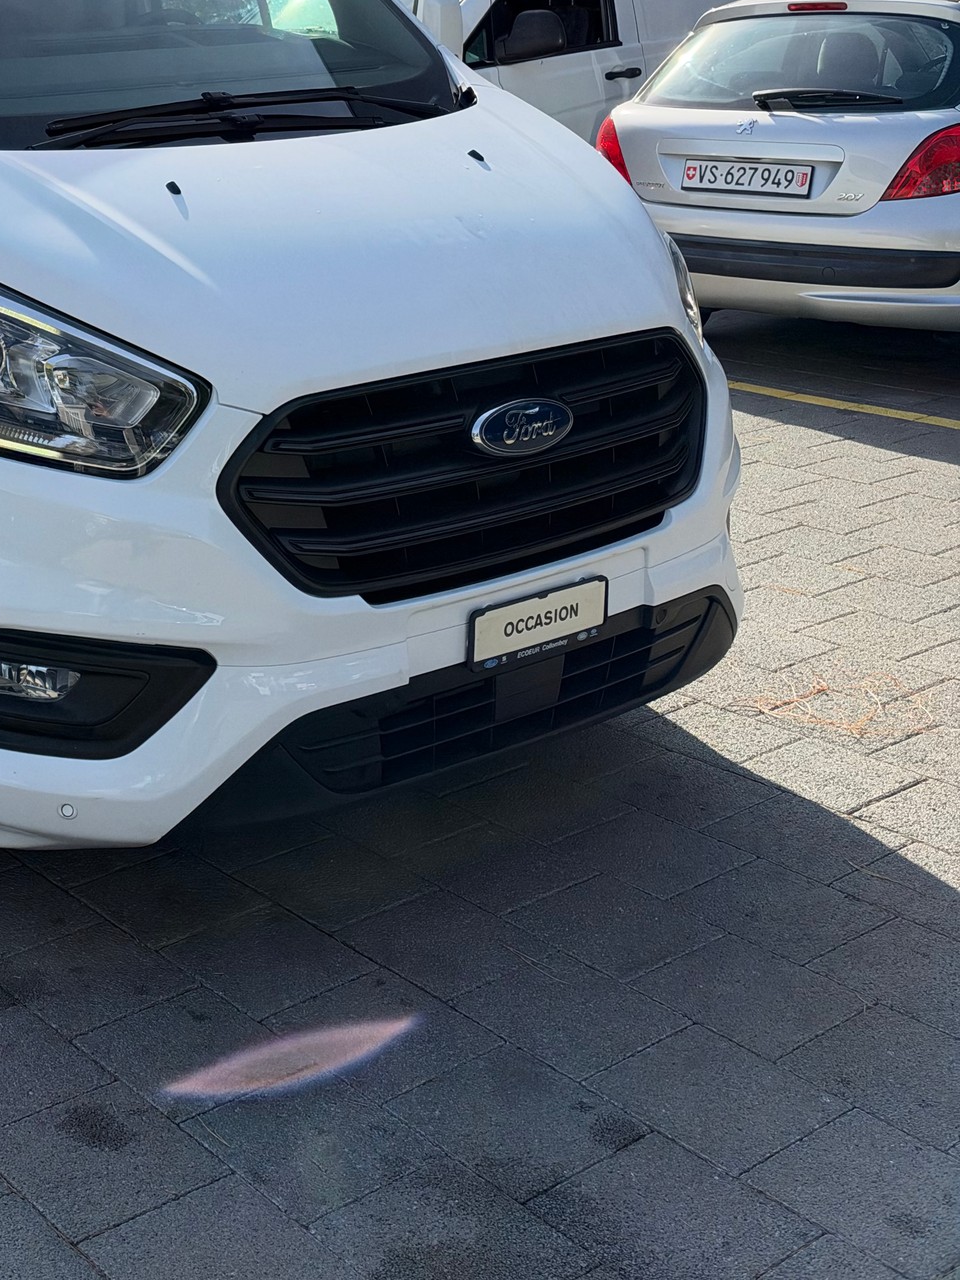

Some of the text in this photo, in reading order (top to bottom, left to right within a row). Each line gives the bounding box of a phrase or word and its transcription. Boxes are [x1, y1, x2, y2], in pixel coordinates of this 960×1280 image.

[837, 192, 864, 201] 207
[503, 406, 561, 445] Ford
[504, 602, 579, 638] OCCASION
[542, 638, 568, 651] Collombey
